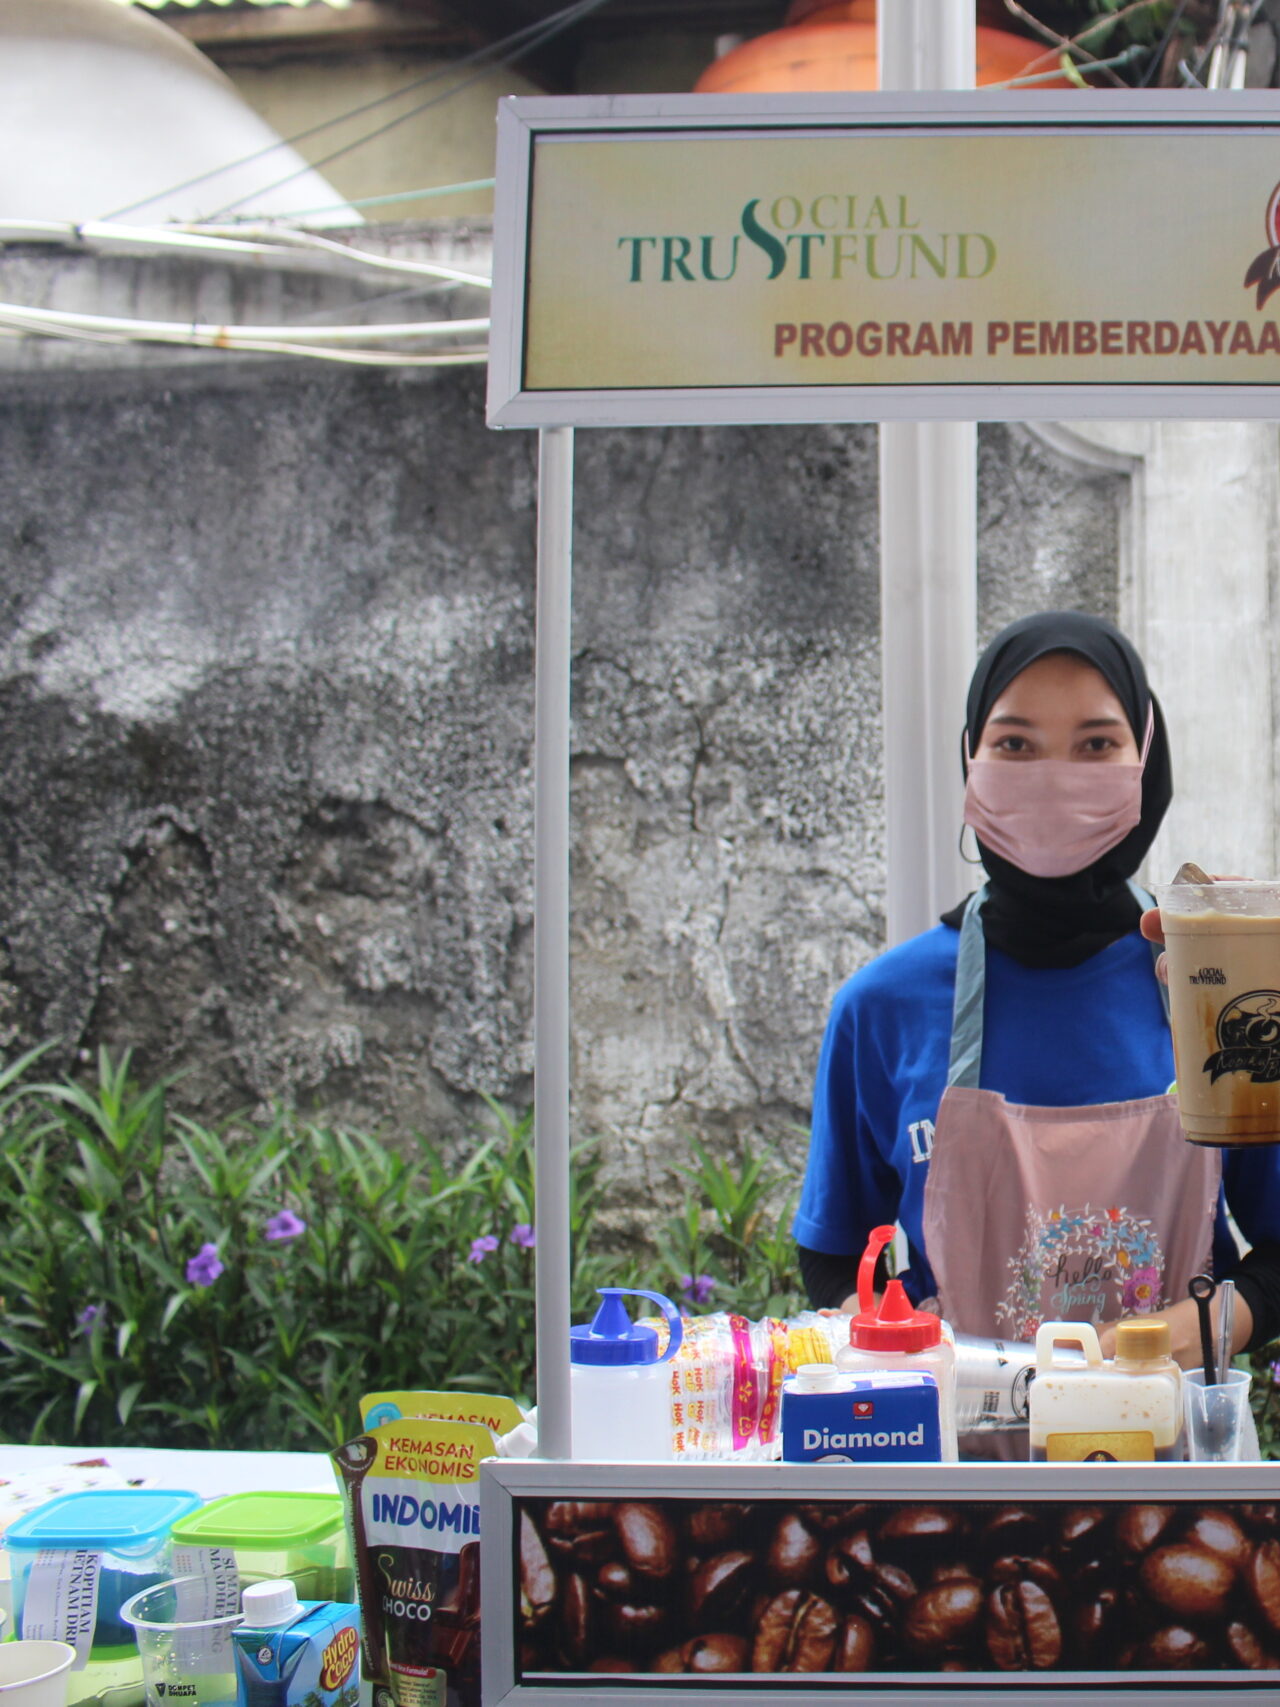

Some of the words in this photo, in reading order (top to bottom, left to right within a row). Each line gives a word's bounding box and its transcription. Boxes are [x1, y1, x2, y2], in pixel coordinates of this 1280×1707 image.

[773, 321, 973, 357] PROGRAM
[1045, 1253, 1112, 1288] hello
[389, 1438, 475, 1460] KEMASAN
[803, 1423, 924, 1450] Diamond
[384, 1455, 475, 1479] EKONOMIS
[67, 1549, 88, 1609] IETNAM
[79, 1554, 98, 1633] KOPITIAM
[378, 1553, 436, 1602] Swiss
[382, 1594, 431, 1622] CHOCO
[323, 1627, 356, 1670] Hydro
